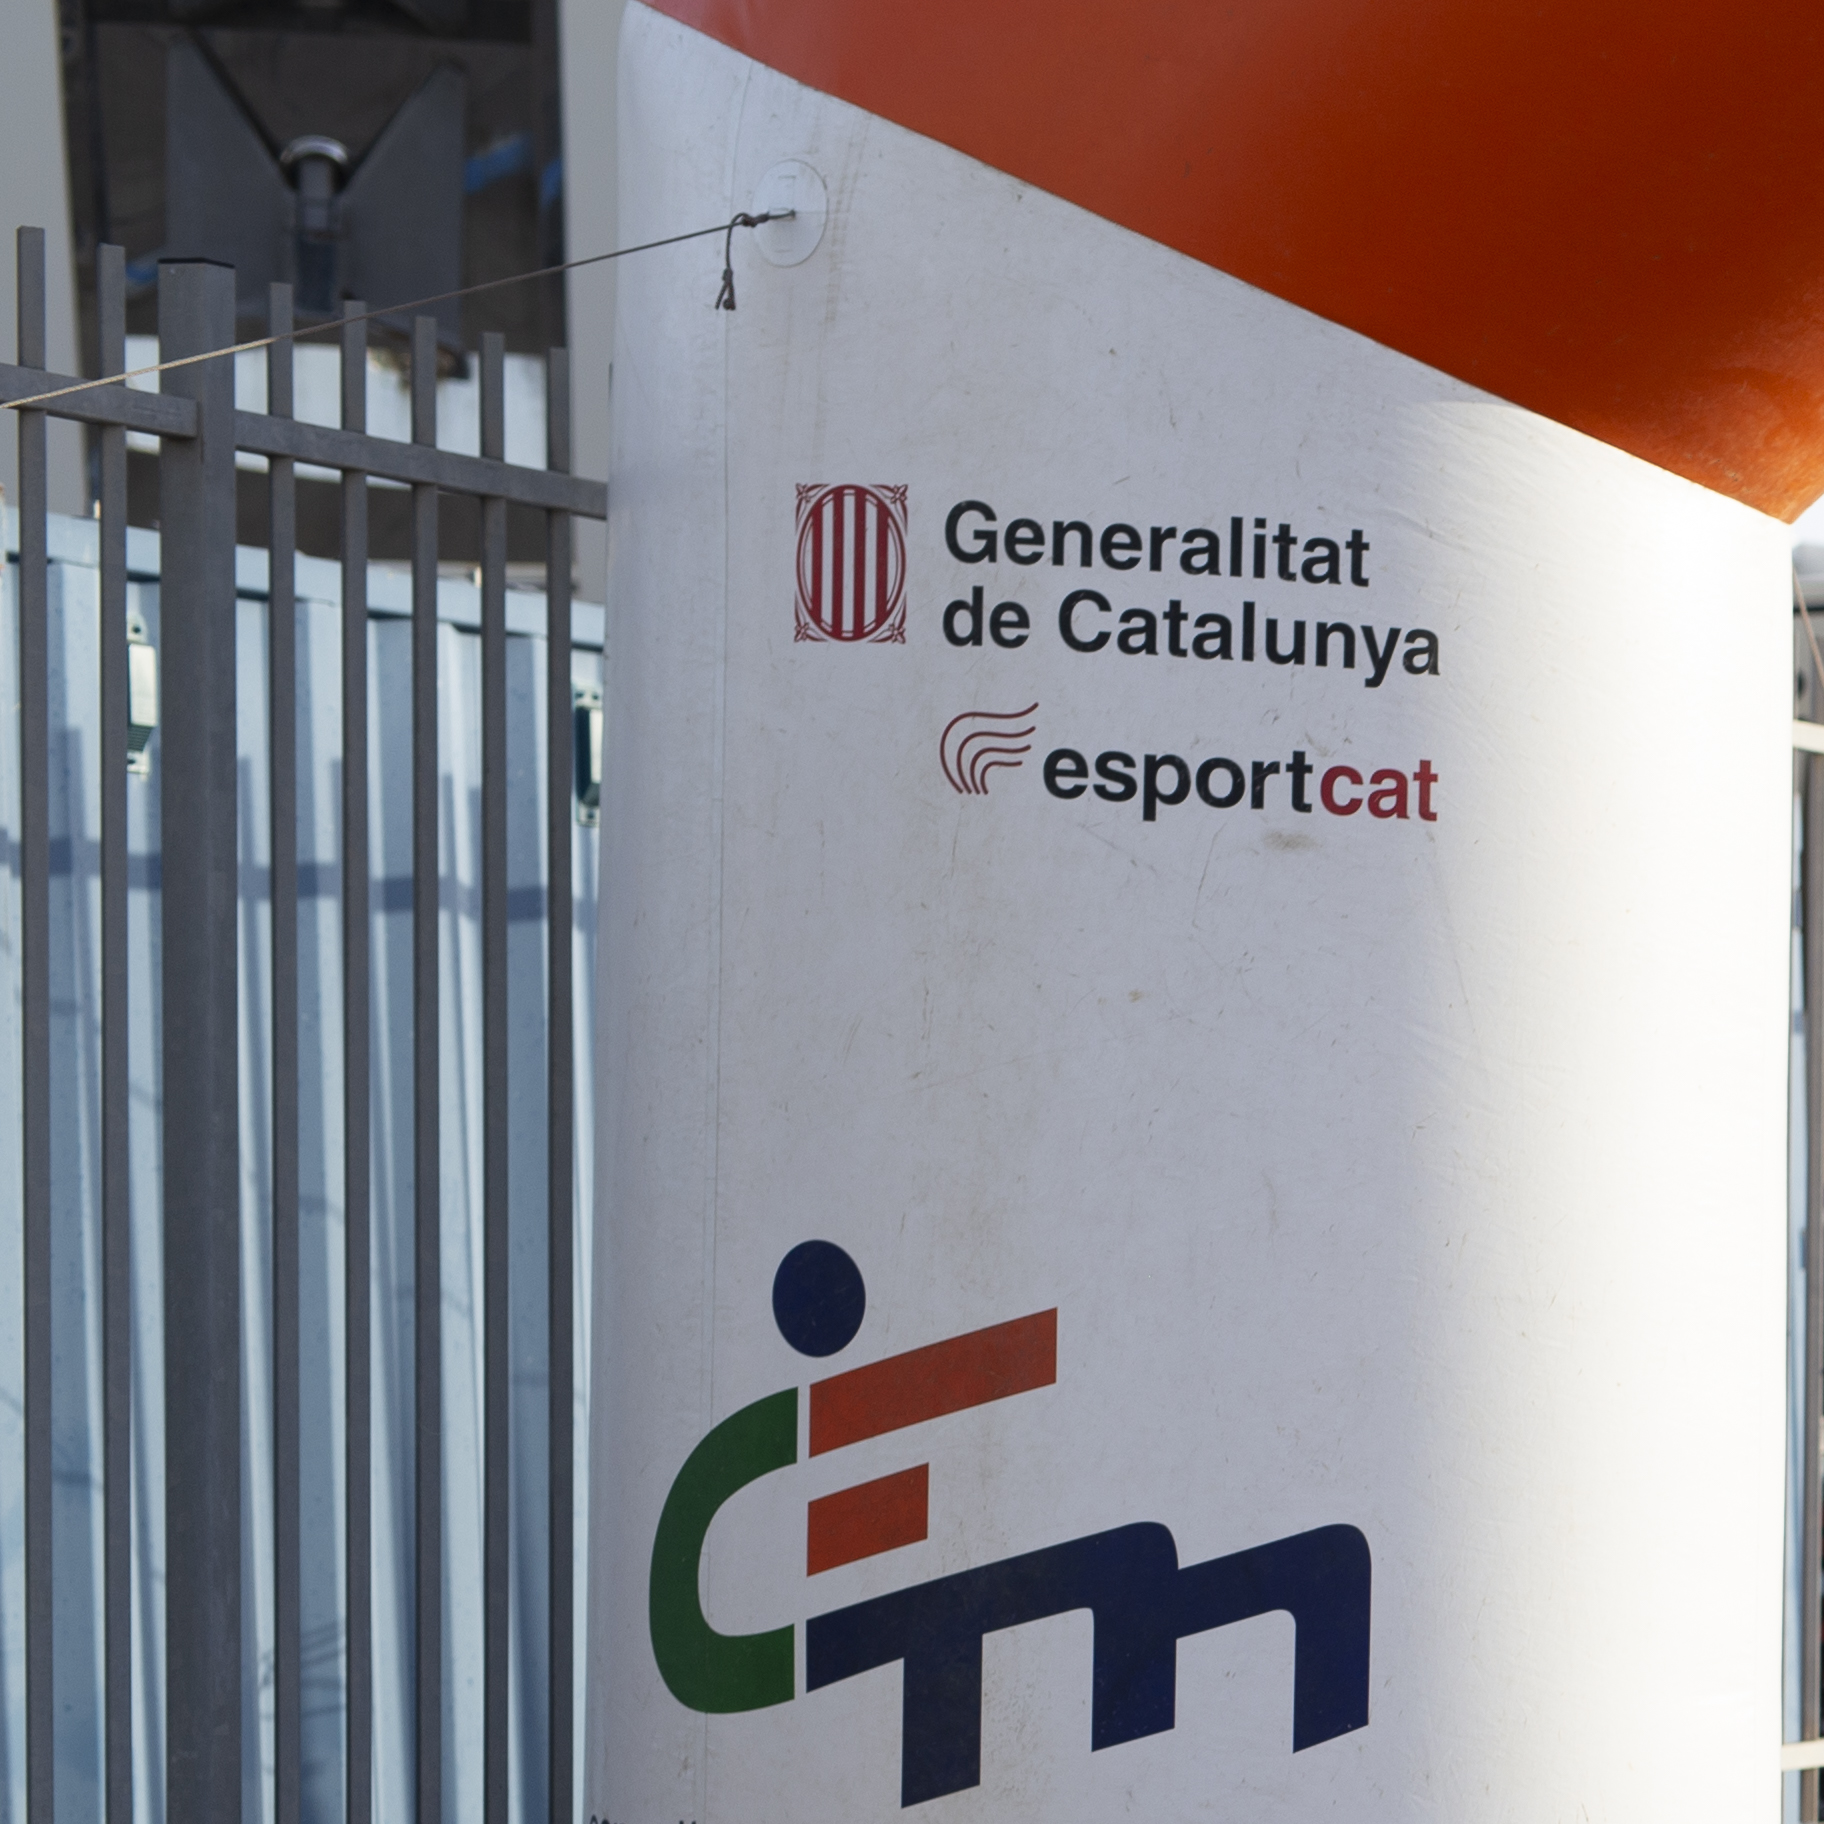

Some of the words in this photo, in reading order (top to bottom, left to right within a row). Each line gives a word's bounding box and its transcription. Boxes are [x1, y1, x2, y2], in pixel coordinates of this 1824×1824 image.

[944, 499, 1370, 588] Generalitat
[941, 586, 1031, 649] de
[1057, 588, 1442, 689] Catalunya
[1042, 746, 1439, 823] esportcat
